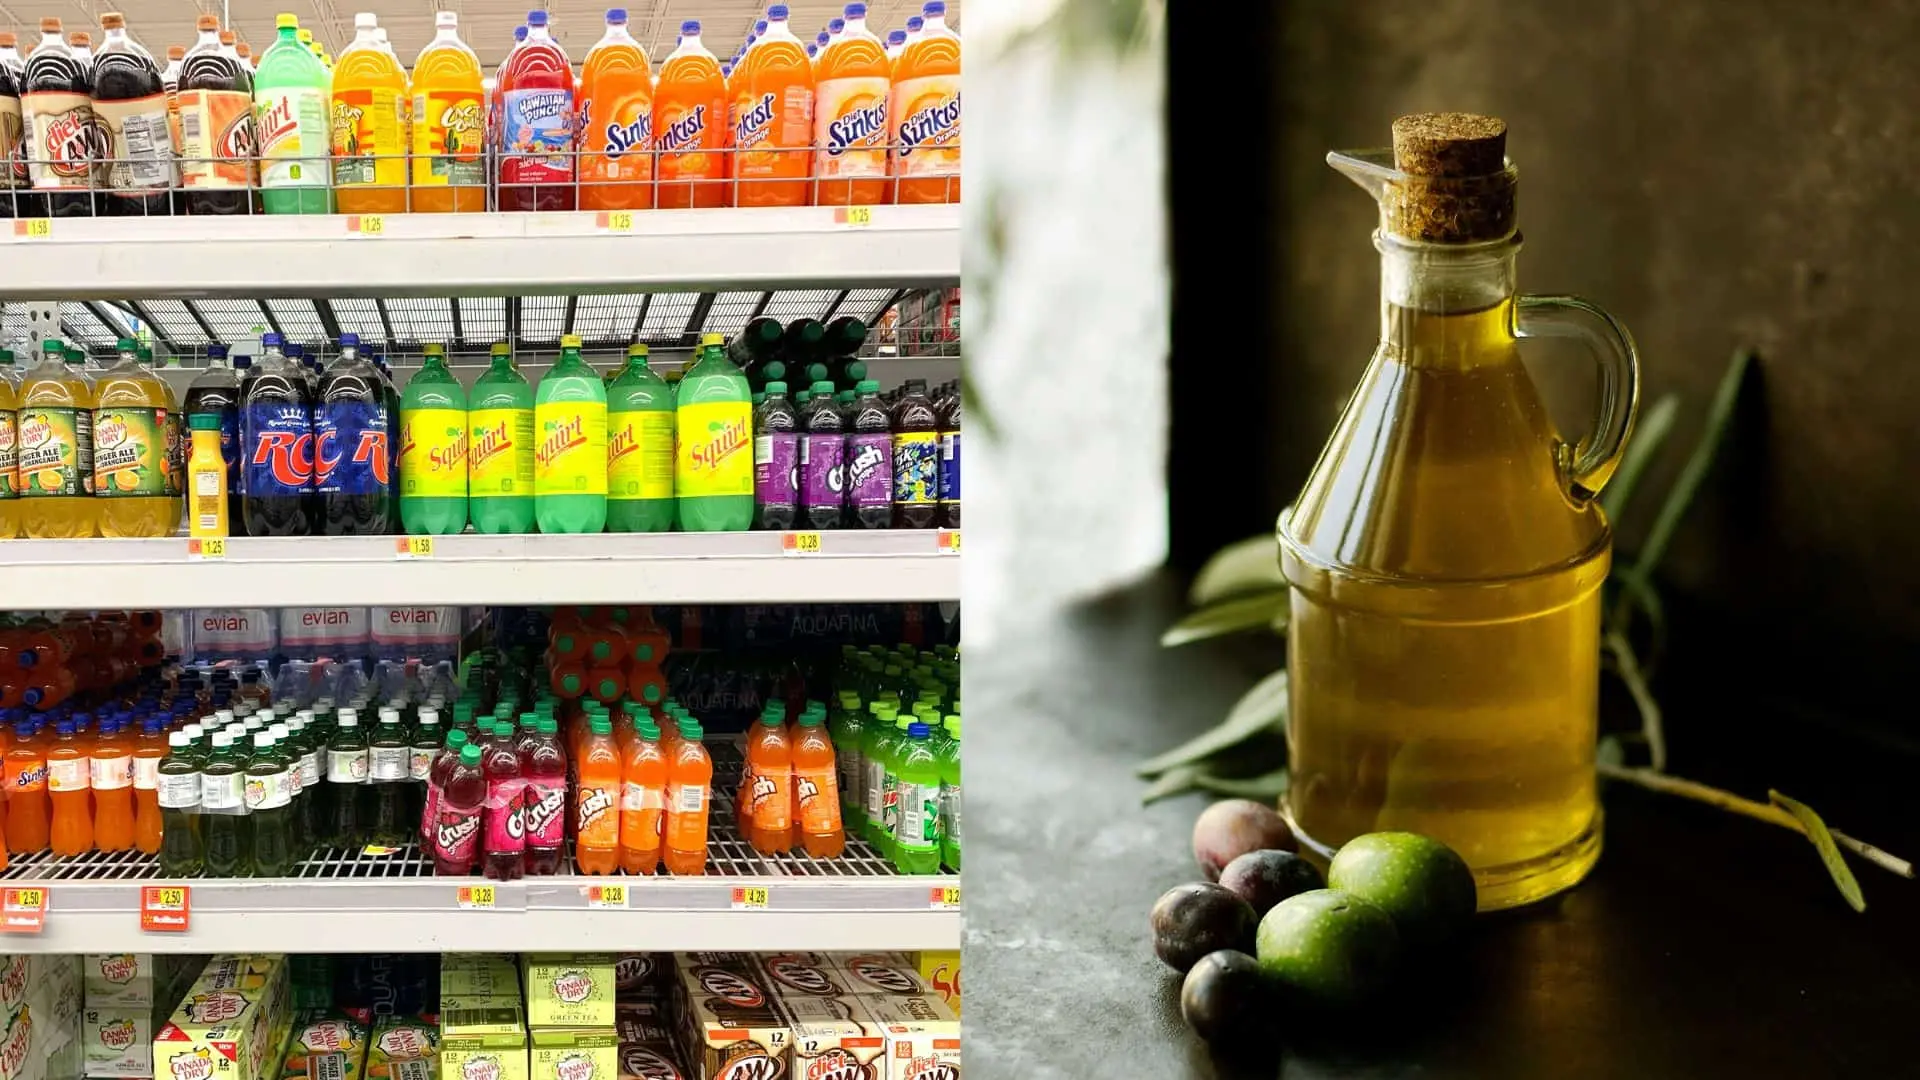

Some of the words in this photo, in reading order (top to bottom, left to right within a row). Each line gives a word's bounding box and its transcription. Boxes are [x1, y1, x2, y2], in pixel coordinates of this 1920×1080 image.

[519, 94, 565, 115] HAWAIIAN
[257, 95, 291, 144] uirt
[526, 105, 560, 124] PUNCH
[736, 95, 775, 141] nkist
[843, 109, 861, 126] Diet
[911, 109, 928, 126] Diet
[47, 110, 81, 152] diet
[605, 110, 653, 158] Sunk
[658, 106, 705, 155] nkist
[935, 127, 960, 145] Orang
[614, 214, 631, 229] 1.25
[852, 208, 869, 222] 1.25
[31, 219, 48, 235] 1.58
[365, 216, 382, 232] 1.25
[468, 420, 507, 470] quirt
[608, 423, 634, 460] uirt
[692, 415, 747, 471] Squirt
[42, 447, 59, 457] ALE
[119, 447, 135, 457] ALE
[352, 430, 389, 485] R
[430, 431, 468, 471] Squir
[849, 445, 884, 491] rush
[206, 540, 223, 554] 1.25
[414, 538, 430, 553] 1.58
[801, 535, 818, 549] 3.28
[203, 617, 248, 631] evian
[302, 609, 349, 626] evian
[389, 608, 438, 624] evian
[790, 613, 880, 637] AQUAFINA
[526, 788, 564, 832] Crush
[578, 789, 614, 831] rush
[438, 815, 480, 848] Crush
[23, 891, 39, 905] 2.50
[165, 891, 181, 904] 2.50
[476, 888, 492, 903] 3.28
[606, 887, 622, 901] 3.28
[749, 889, 765, 903] 4.28
[949, 889, 960, 903] 3.2
[102, 959, 138, 976] CANADA
[113, 970, 130, 979] DRY
[372, 954, 398, 1016] QUAFI
[556, 977, 592, 996] CANADA
[567, 988, 585, 998] DRY
[202, 991, 224, 1024] CANADA
[222, 998, 237, 1013] DRY
[582, 1014, 599, 1022] TEA
[101, 1026, 136, 1044] CANADA
[112, 1036, 129, 1045] DRY
[309, 1030, 325, 1047] DRY
[771, 1032, 784, 1043] 12
[387, 1036, 402, 1053] DRY
[805, 1040, 818, 1051] 12
[171, 1057, 214, 1075] CANADA
[218, 1058, 230, 1067] 12
[410, 1062, 423, 1080] GINGE
[463, 1062, 500, 1079] CANADA
[557, 1061, 594, 1079] CANADA
[808, 1051, 846, 1078] diet
[905, 1057, 937, 1078] diet
[184, 1067, 205, 1080] DRY
